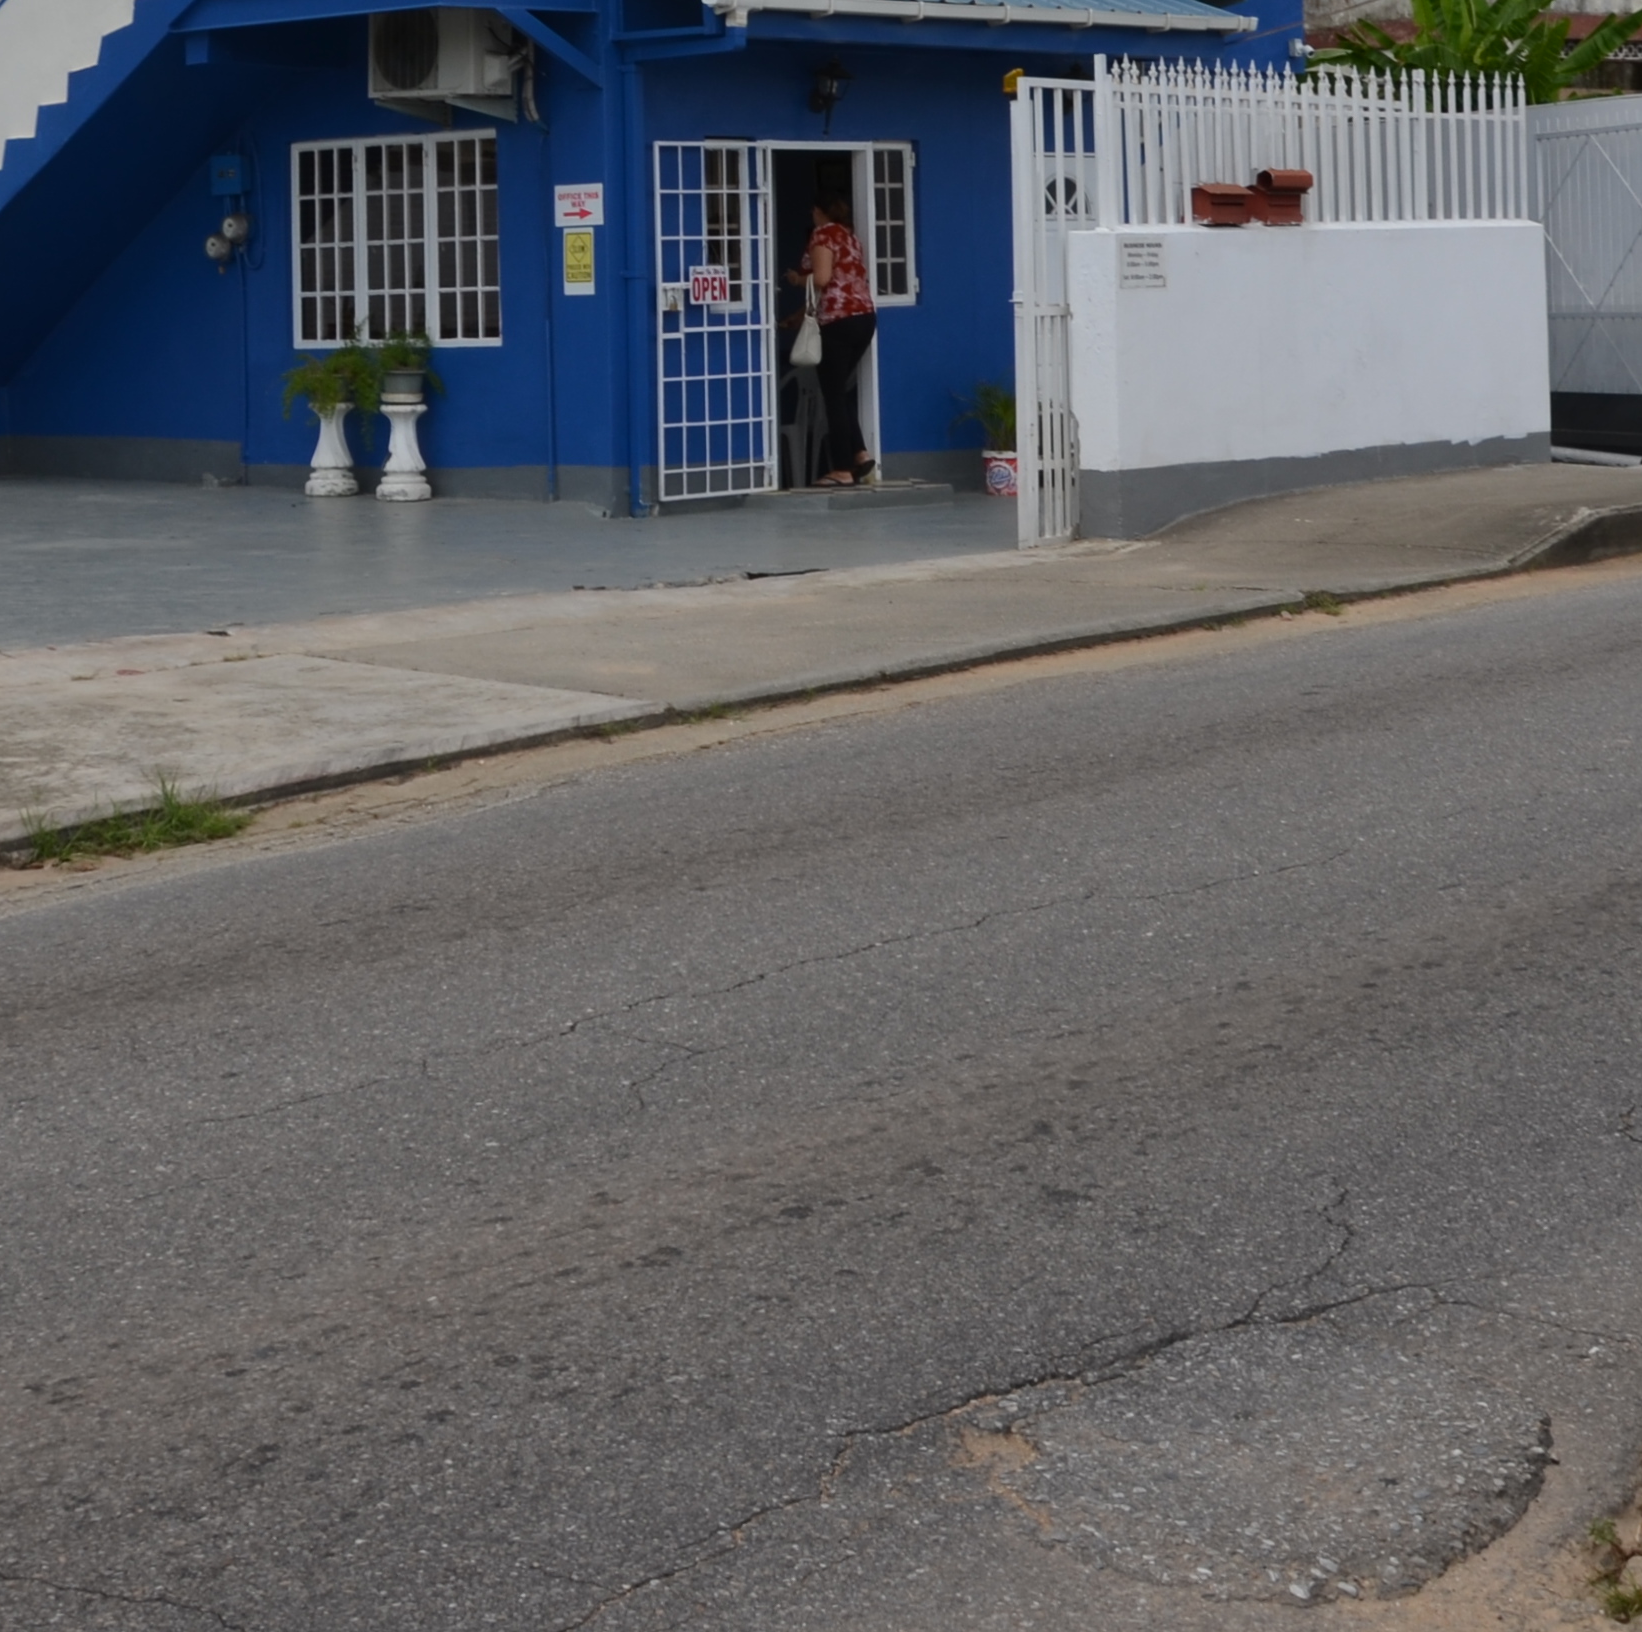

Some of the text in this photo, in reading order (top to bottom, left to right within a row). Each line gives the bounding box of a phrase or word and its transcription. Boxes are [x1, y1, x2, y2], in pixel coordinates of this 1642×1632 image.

[558, 191, 599, 201] OFFICE THIS
[571, 200, 586, 208] WAY
[692, 277, 727, 302] OPEN
